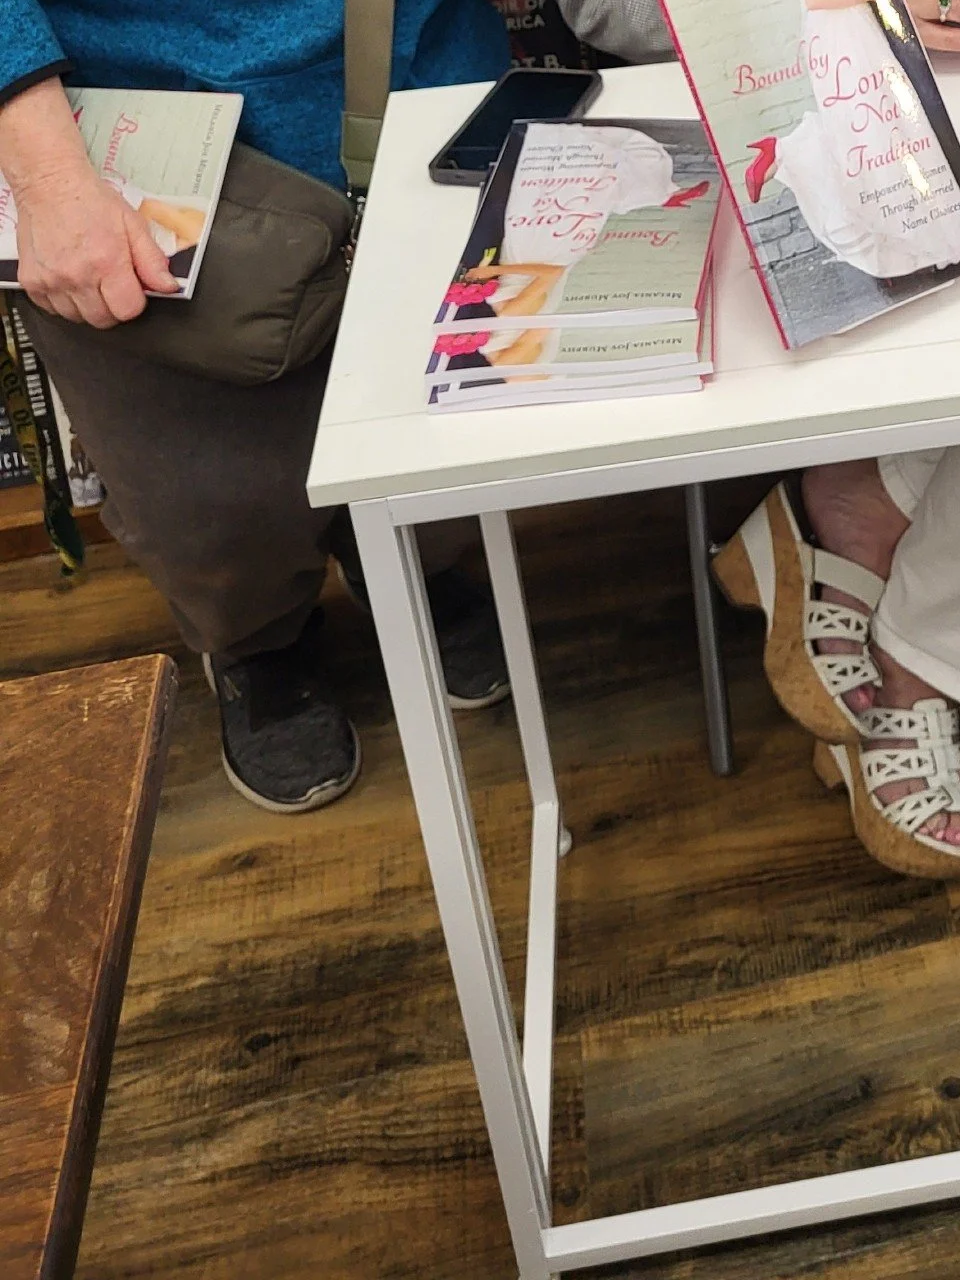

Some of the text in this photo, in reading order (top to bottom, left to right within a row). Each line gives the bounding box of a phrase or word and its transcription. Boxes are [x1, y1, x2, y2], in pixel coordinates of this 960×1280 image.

[731, 35, 830, 96] Bound by
[851, 94, 901, 133] Not
[846, 126, 931, 178] Tradition
[520, 173, 618, 193] Tradition
[533, 191, 590, 209] Not
[507, 211, 604, 238] Love,
[902, 214, 928, 232] Name
